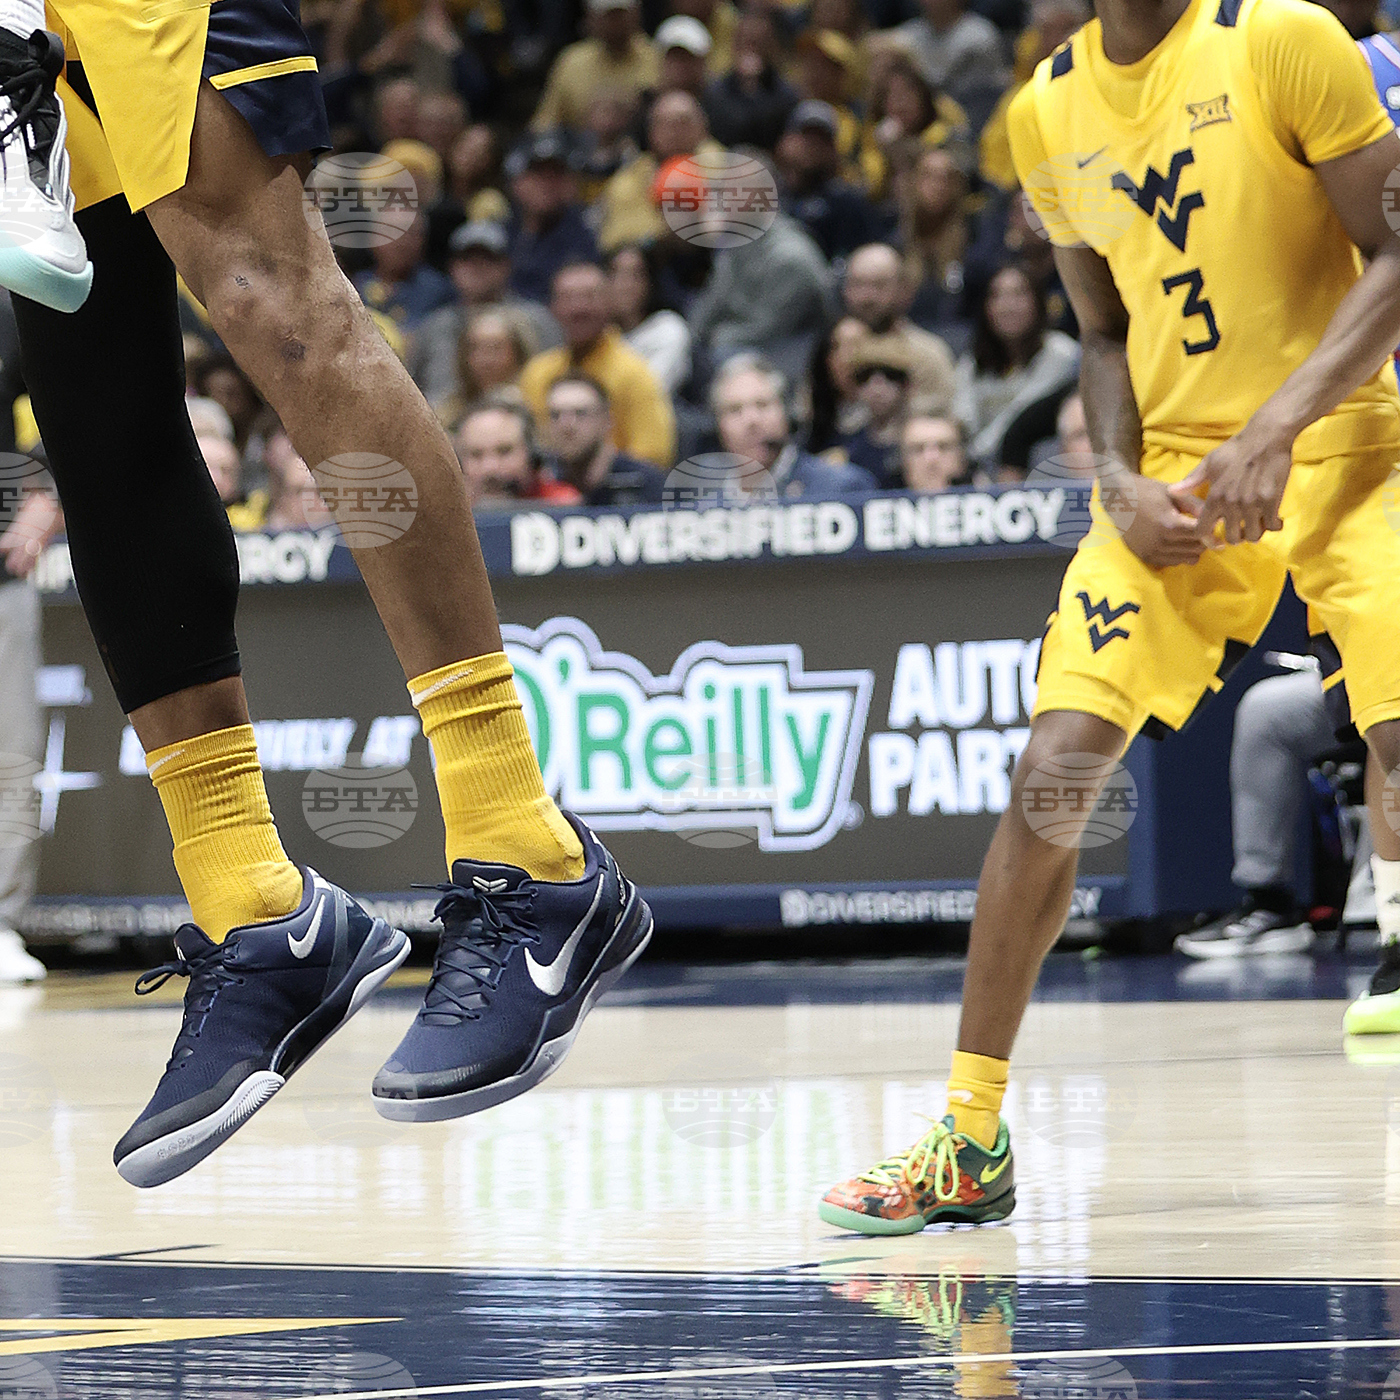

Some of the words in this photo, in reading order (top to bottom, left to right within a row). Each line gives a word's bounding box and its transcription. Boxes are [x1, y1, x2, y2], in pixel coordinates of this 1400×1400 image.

[1162, 267, 1221, 356] 3
[561, 506, 859, 567] DIVERSIFIED
[863, 487, 1066, 551] ENERGY
[869, 728, 1031, 818] PAR
